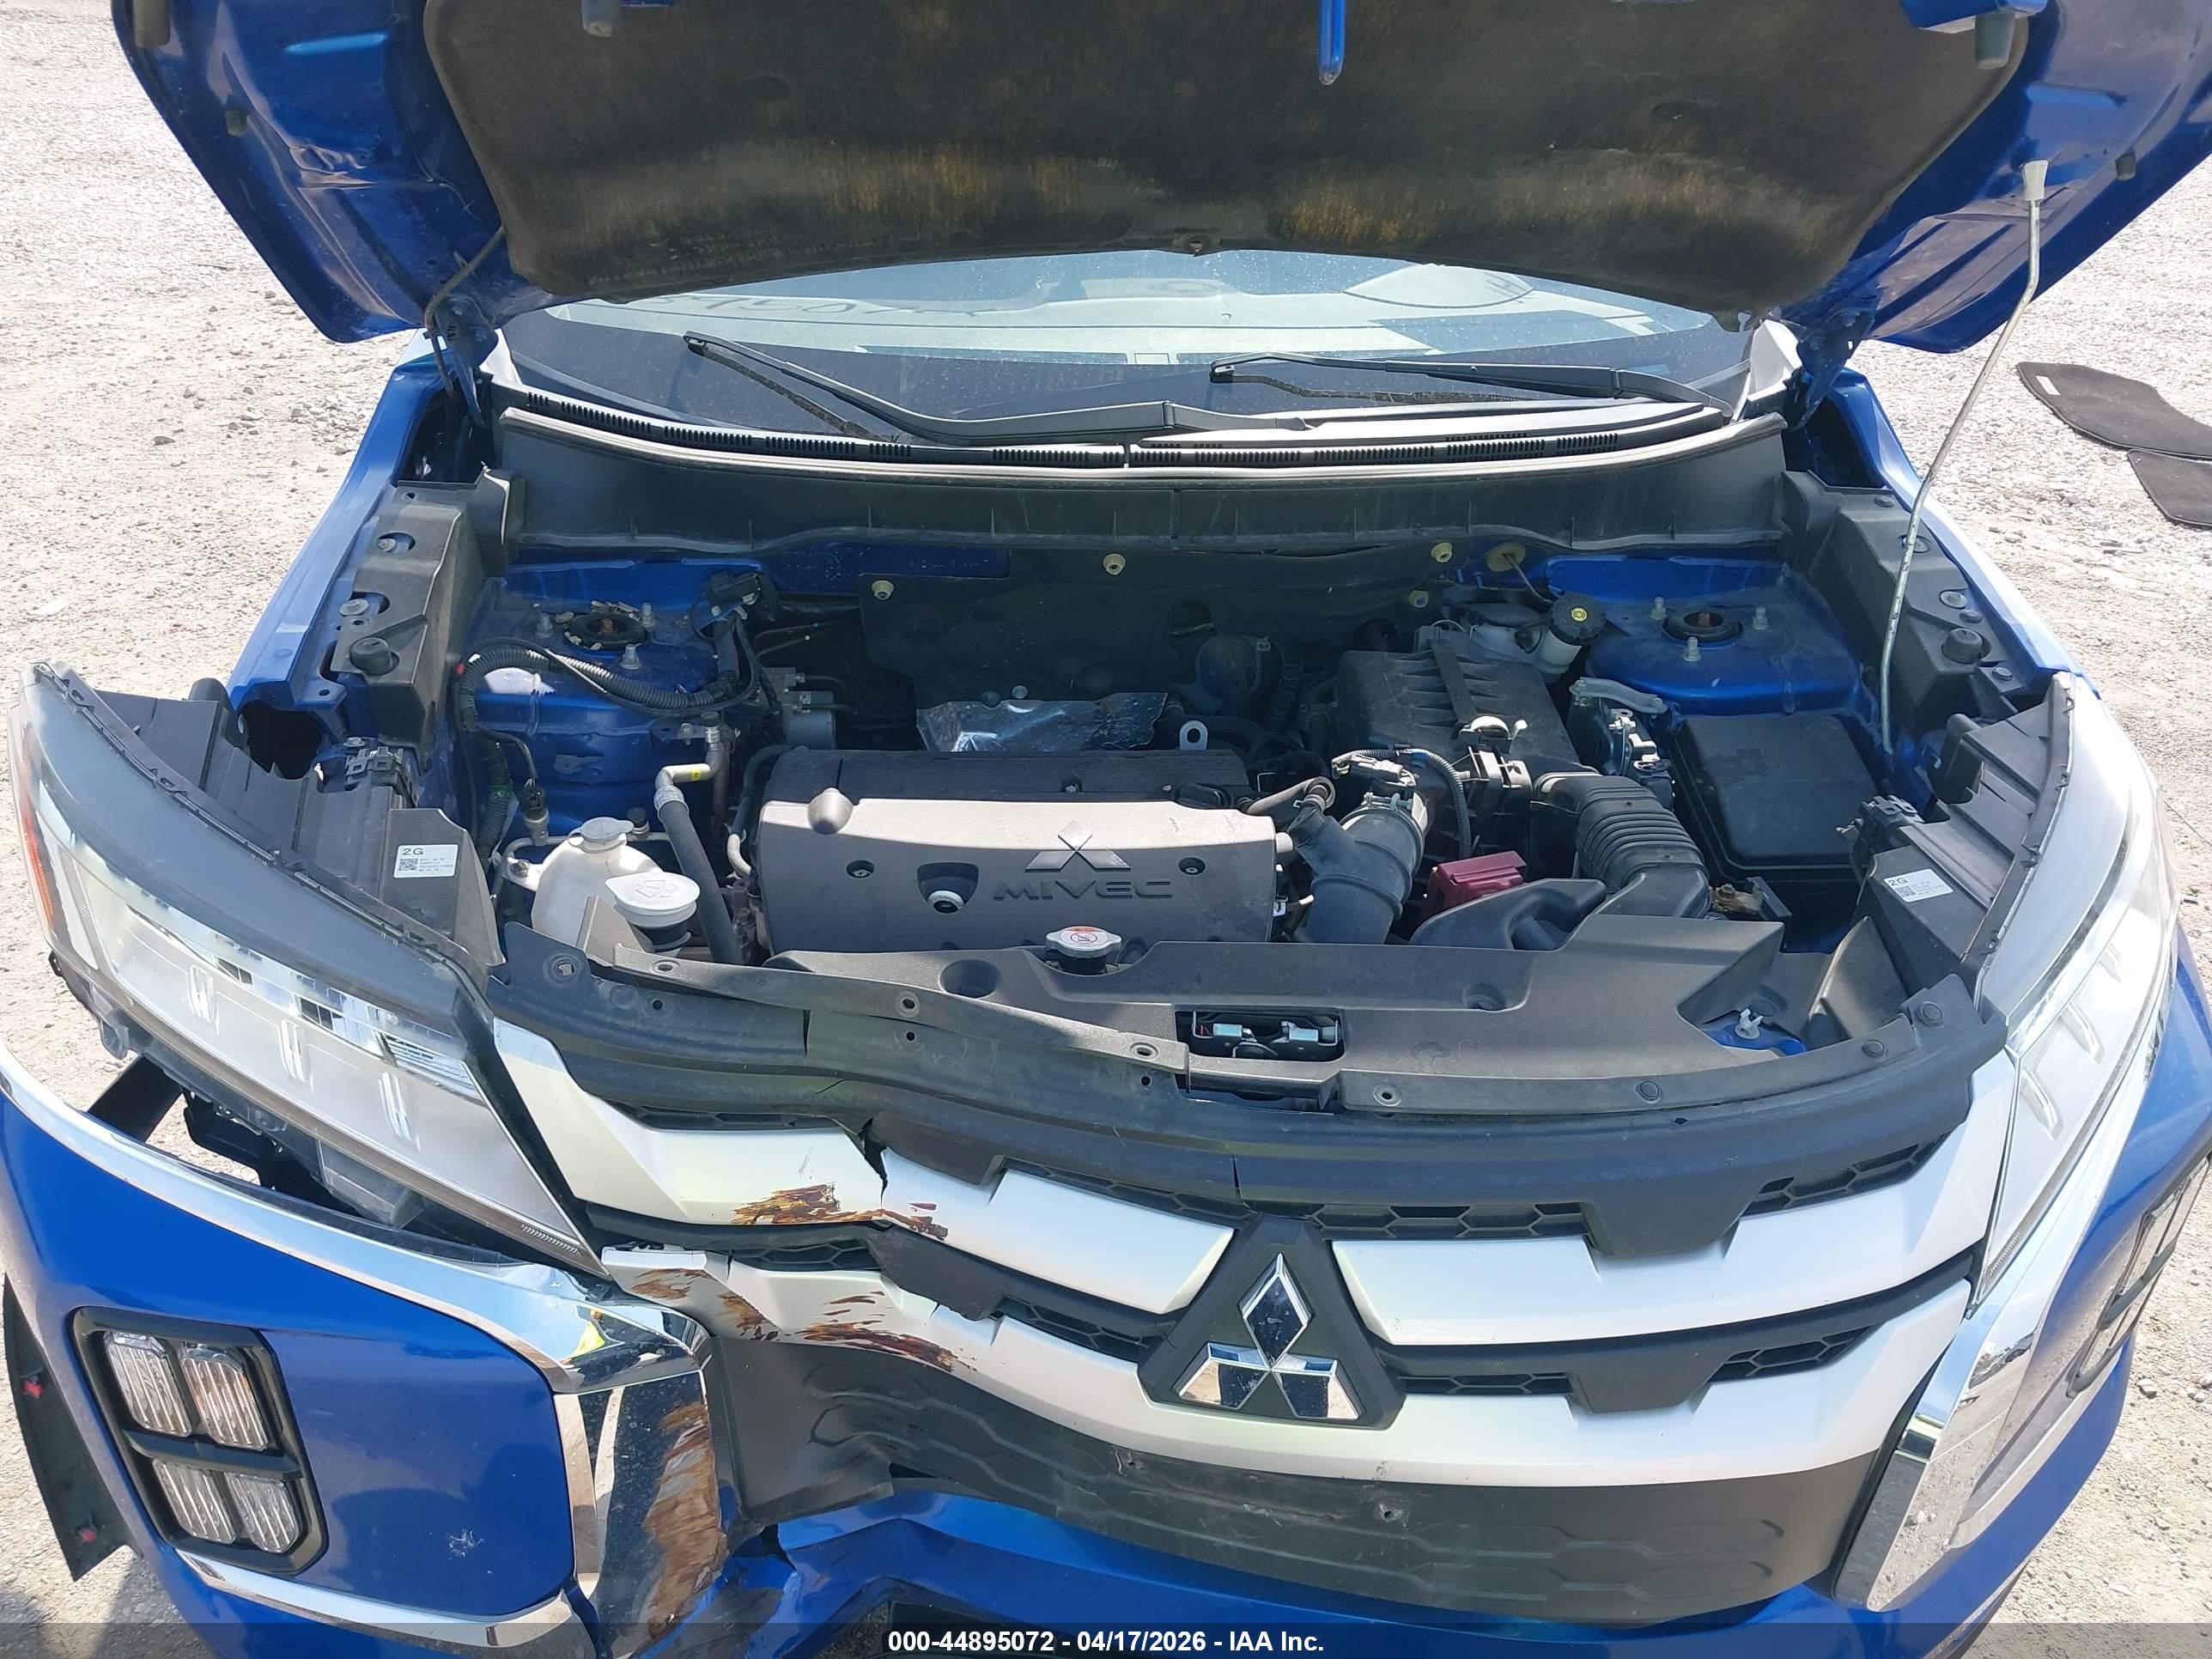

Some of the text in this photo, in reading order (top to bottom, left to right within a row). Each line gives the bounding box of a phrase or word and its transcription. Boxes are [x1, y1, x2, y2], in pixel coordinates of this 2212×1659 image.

[402, 847, 424, 856] 2G
[1888, 877, 1909, 887] 2G
[993, 878, 1174, 901] MIVEC
